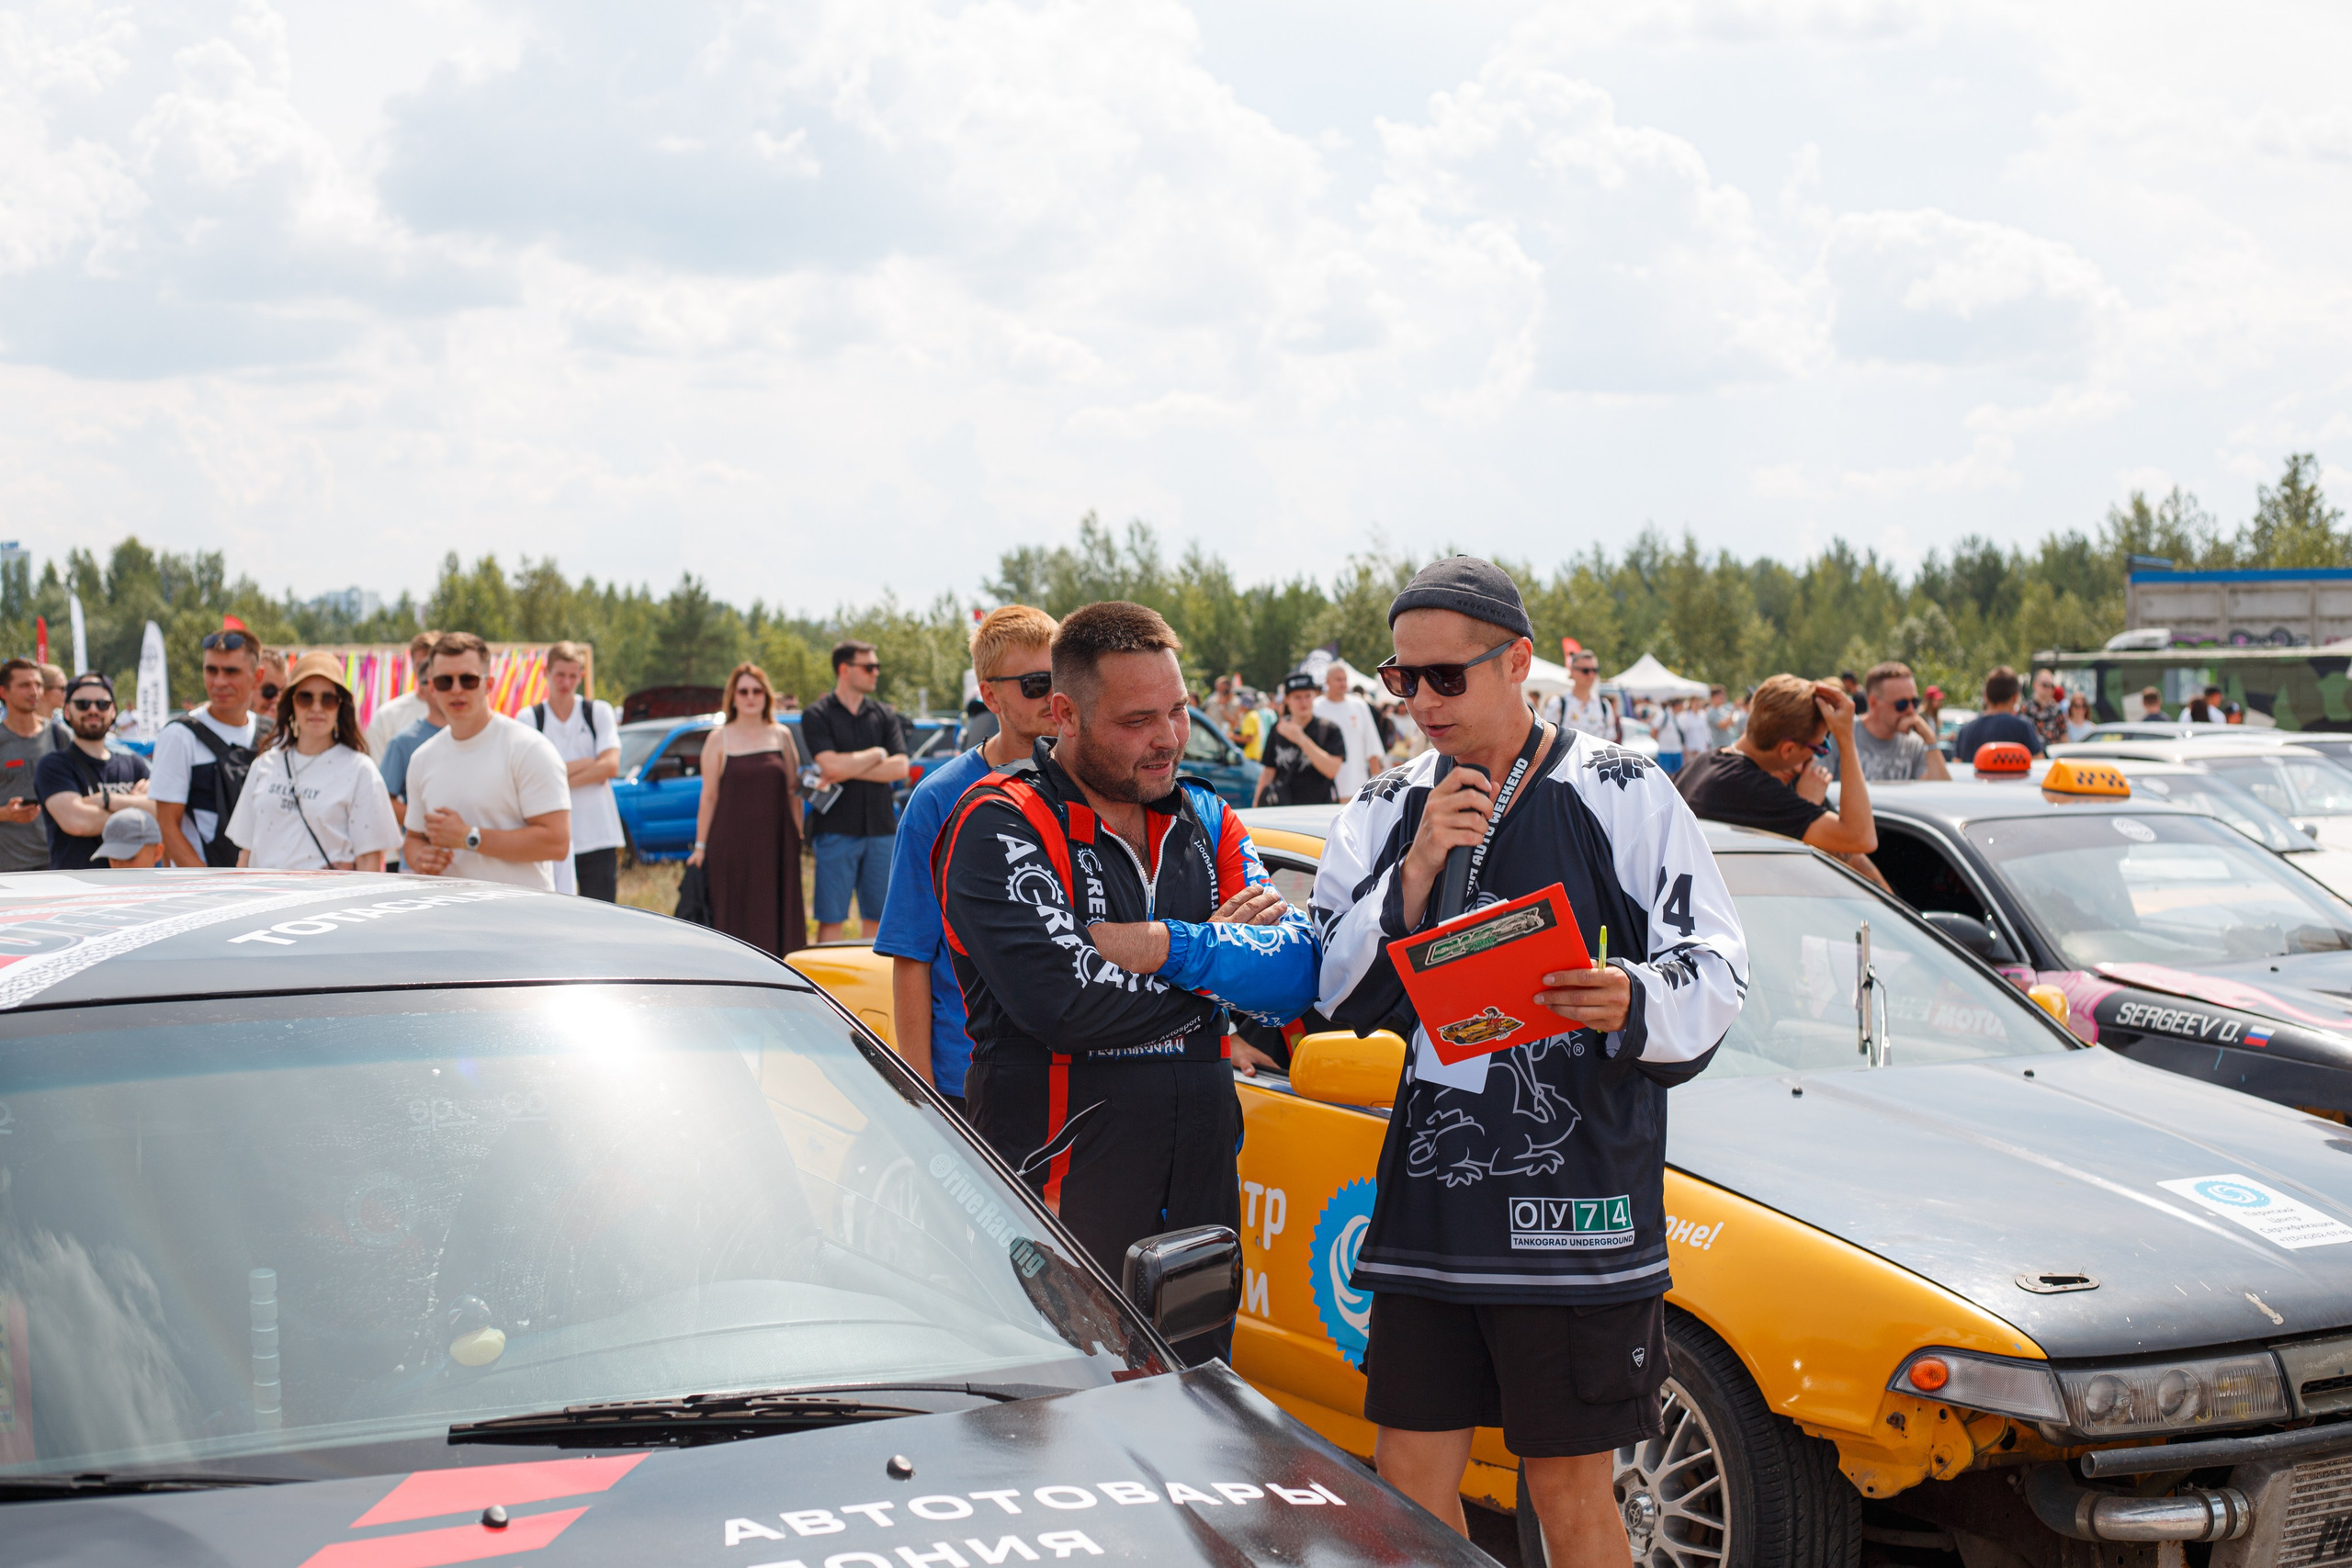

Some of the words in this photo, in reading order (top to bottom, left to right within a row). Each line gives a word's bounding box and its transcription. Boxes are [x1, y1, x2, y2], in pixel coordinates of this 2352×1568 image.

[1488, 757, 1529, 824] WEEKEND
[2116, 1002, 2222, 1037] SERGEEV
[2218, 1020, 2243, 1043] D.
[1513, 1237, 1567, 1247] TANKOGRAD
[1569, 1235, 1634, 1247] UNDERGROUND
[725, 1481, 1347, 1546] АВТОТОВАРЫ
